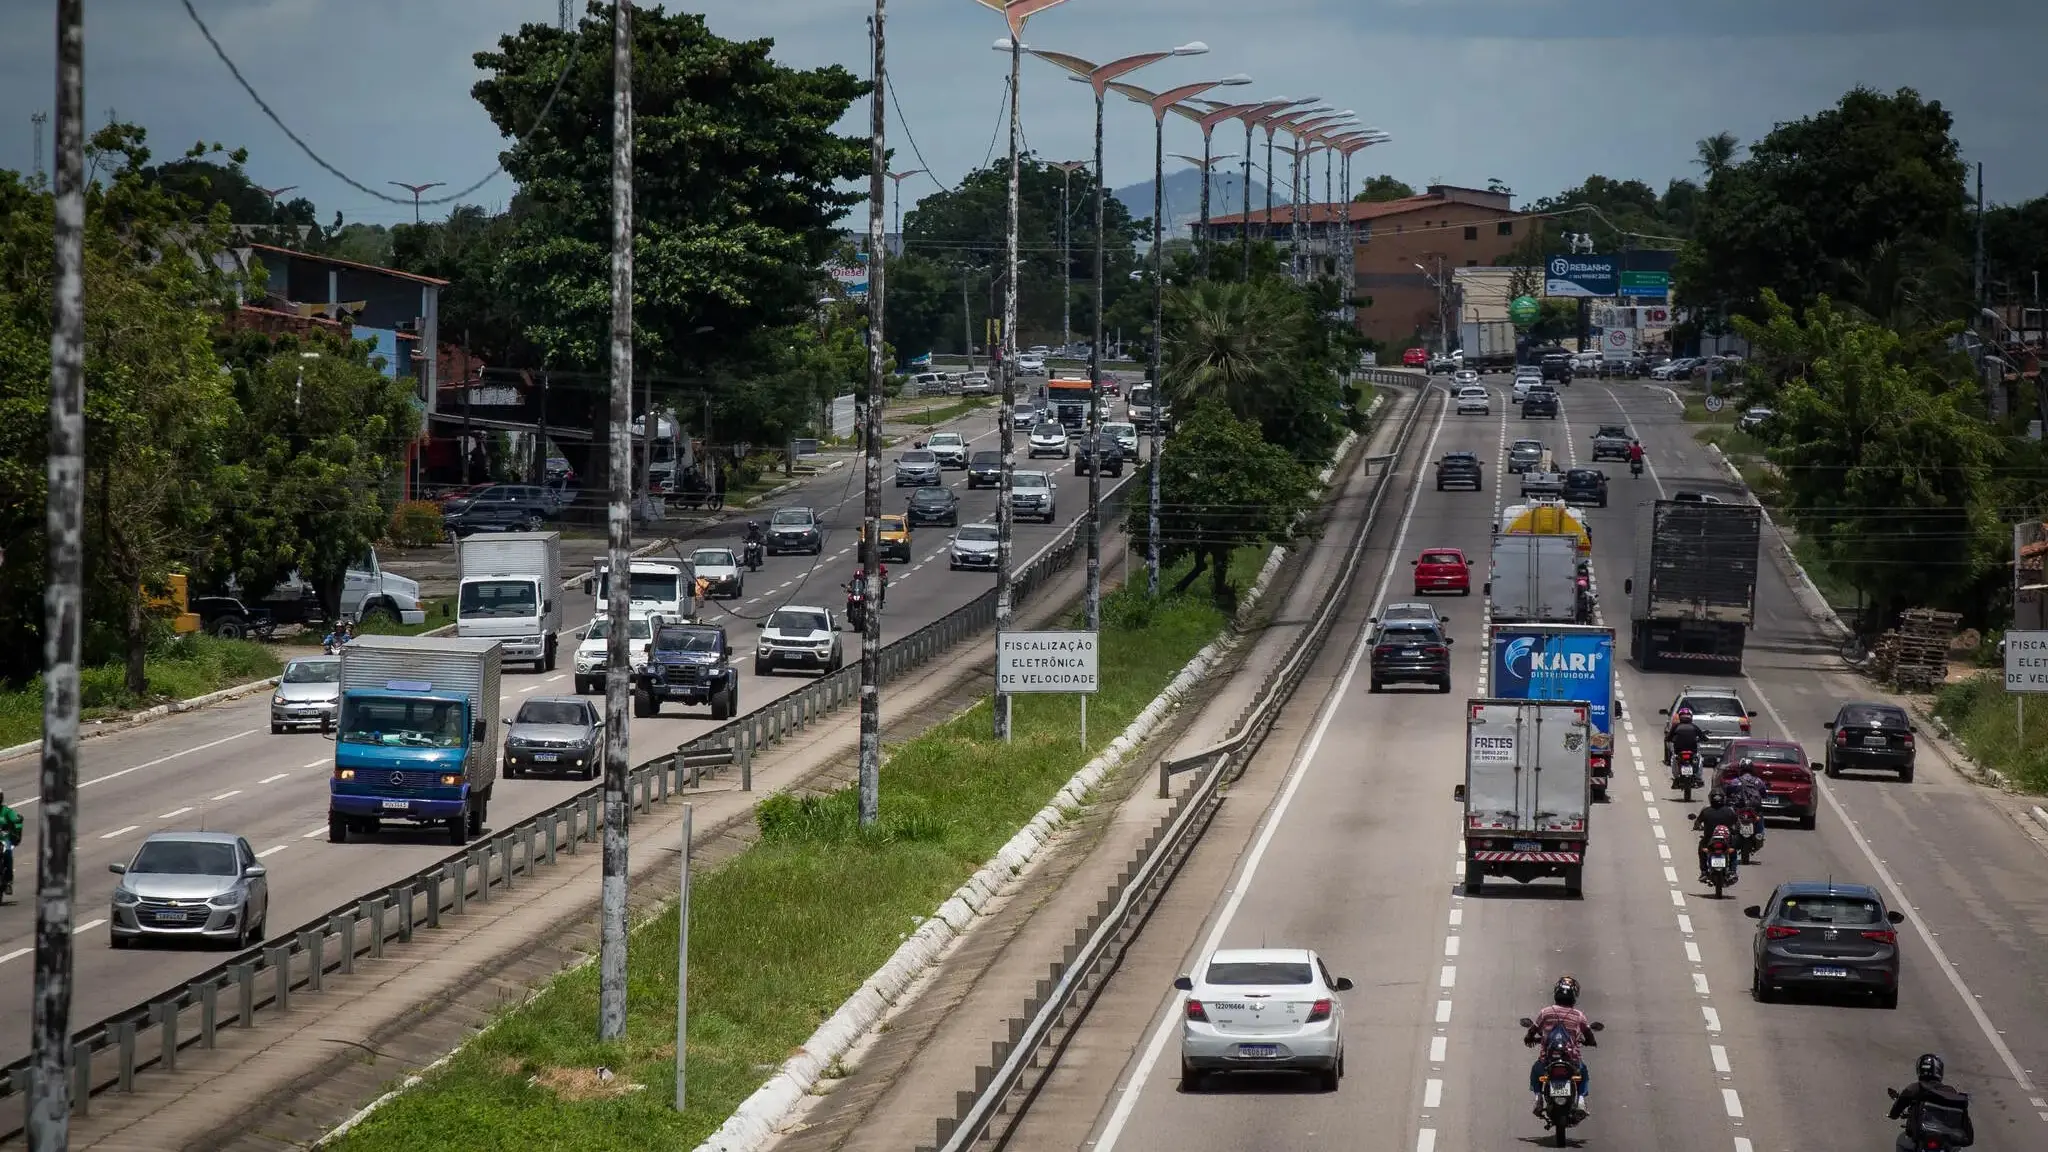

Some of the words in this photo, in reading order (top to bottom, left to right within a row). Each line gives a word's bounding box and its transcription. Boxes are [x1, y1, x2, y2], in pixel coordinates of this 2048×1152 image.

[834, 268, 865, 277] Diesel
[1569, 263, 1611, 272] REBANHO
[1707, 397, 1721, 406] 60
[1004, 639, 1092, 652] FISCALIZAÇÃO
[1012, 656, 1085, 668] ELETRÔNICA
[1001, 674, 1016, 684] DE
[1022, 674, 1095, 684] VELOCIDADE
[2008, 673, 2023, 684] DE
[1475, 737, 1513, 748] FRETES
